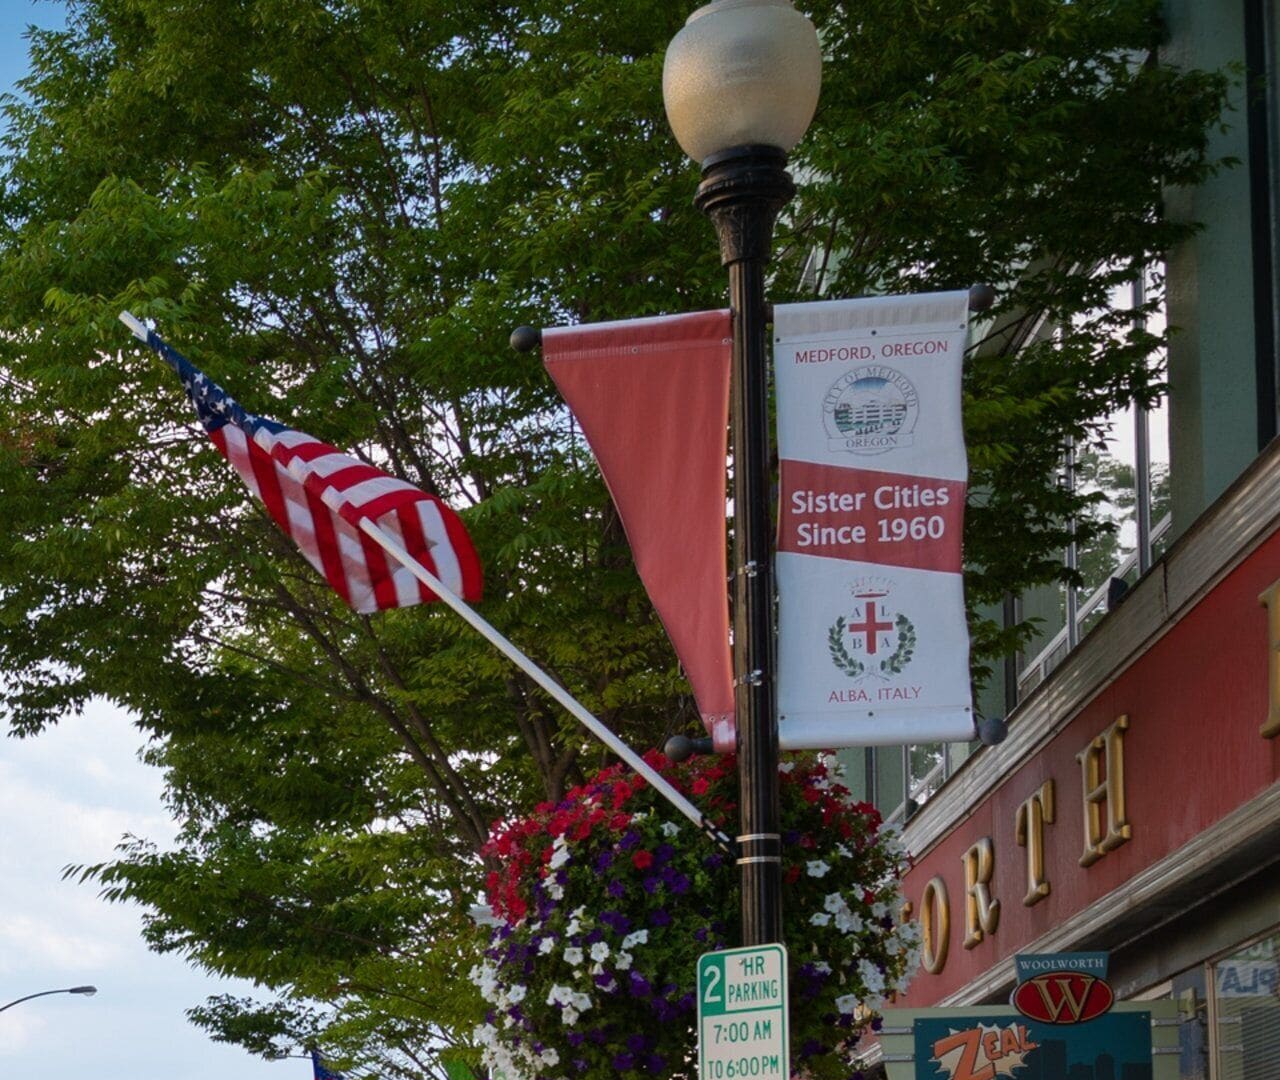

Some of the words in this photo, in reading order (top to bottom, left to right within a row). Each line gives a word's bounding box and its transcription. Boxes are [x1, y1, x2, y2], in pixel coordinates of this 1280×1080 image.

[795, 347, 876, 364] MEDFORD,
[881, 340, 948, 357] OREGON
[824, 386, 843, 414] CITY
[844, 370, 861, 385] OF
[866, 367, 918, 407] MEDFORD
[846, 436, 898, 449] OREGON
[791, 490, 866, 515] Sister
[874, 485, 949, 510] Cities
[797, 523, 866, 546] Since
[877, 515, 945, 542] 1960
[828, 689, 872, 703] ALBA,
[878, 686, 922, 700] ITALY
[916, 714, 1132, 975] ORTH
[1020, 958, 1104, 970] WOOLWORTH
[703, 965, 721, 1003] 2
[744, 956, 765, 976] HR
[728, 980, 778, 1003] PARKING
[1032, 978, 1097, 1022] W
[714, 1022, 749, 1044] 7:00
[753, 1020, 772, 1041] AM
[708, 1060, 724, 1079] TO
[726, 1056, 760, 1078] 6:00
[762, 1055, 779, 1075] PM
